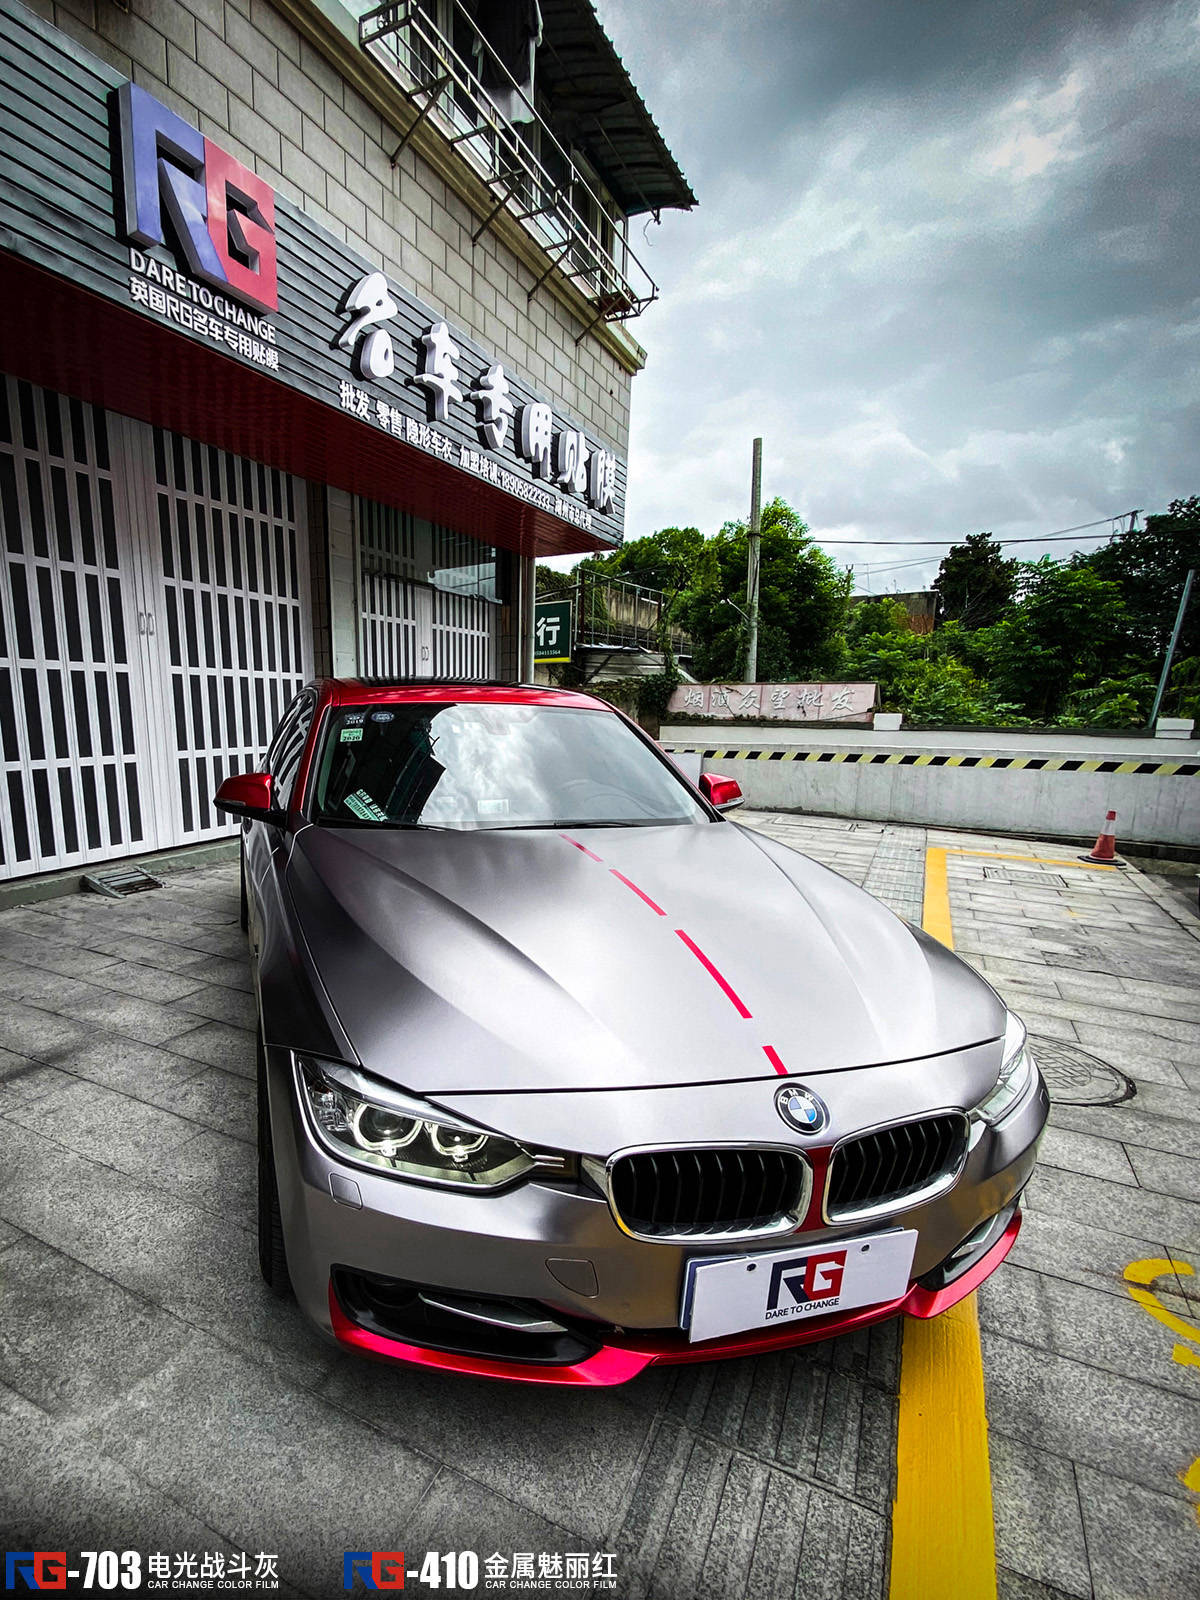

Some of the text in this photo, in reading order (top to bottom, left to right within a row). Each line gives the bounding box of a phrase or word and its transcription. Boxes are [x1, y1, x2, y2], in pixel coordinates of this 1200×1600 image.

[129, 276, 280, 372] 英国RG名车专用贴膜
[338, 271, 617, 515] 名车专用贴膜
[339, 379, 371, 421] 批发
[376, 399, 403, 438] 零售
[406, 416, 453, 461] 隐形车衣
[536, 616, 561, 646] 行
[779, 1088, 815, 1105] BMW
[764, 1297, 840, 1320] DARE TO CHANGE
[766, 1249, 848, 1311] RG
